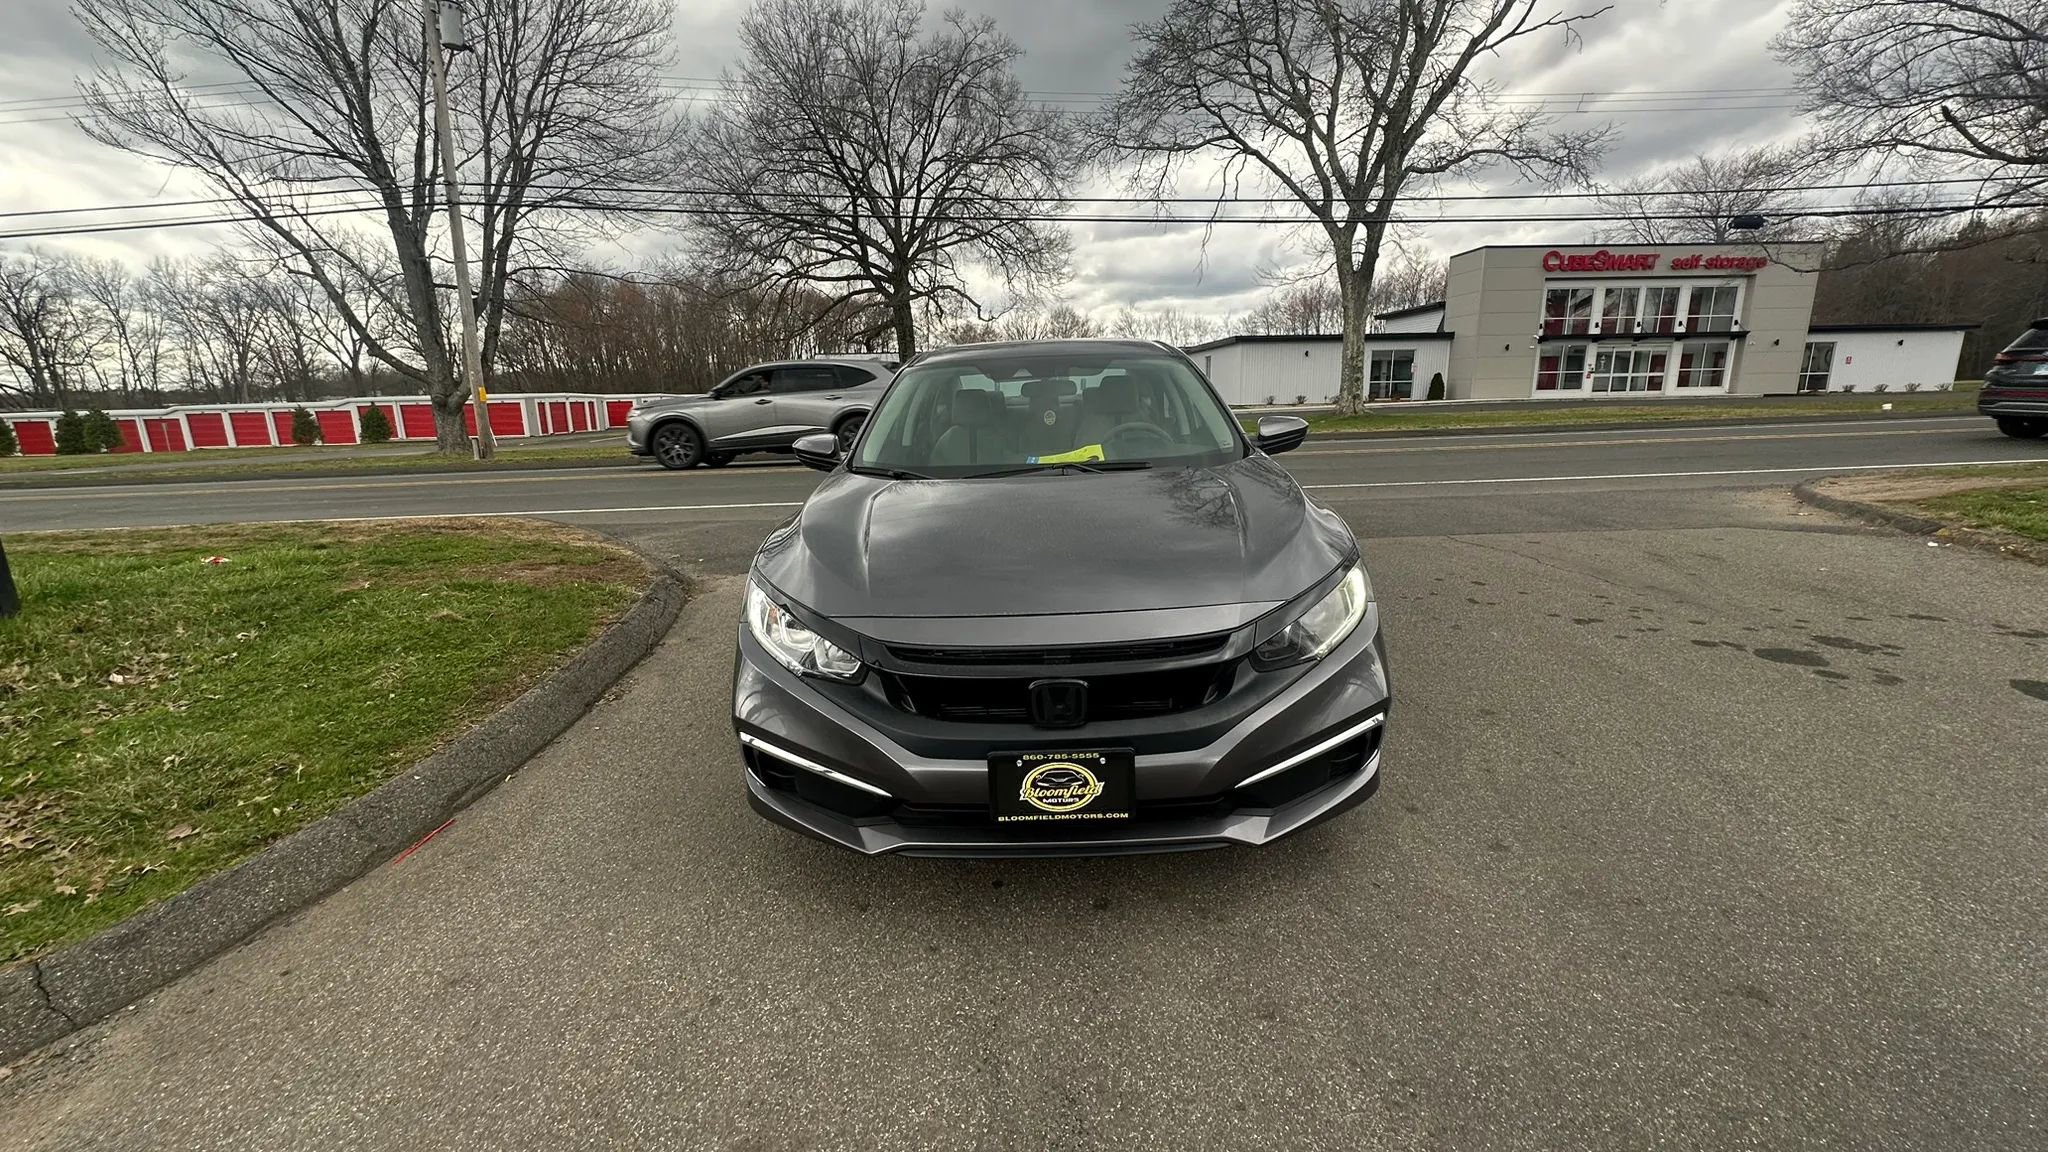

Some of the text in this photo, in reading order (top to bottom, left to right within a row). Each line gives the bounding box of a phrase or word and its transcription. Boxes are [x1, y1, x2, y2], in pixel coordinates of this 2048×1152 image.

[1670, 254, 1703, 270] self
[1703, 254, 1768, 272] storage
[1022, 753, 1100, 761] 860-785-5555
[1024, 784, 1101, 798] Bloomfield
[998, 812, 1129, 822] BLOOMFIELDMOTORS.COM
